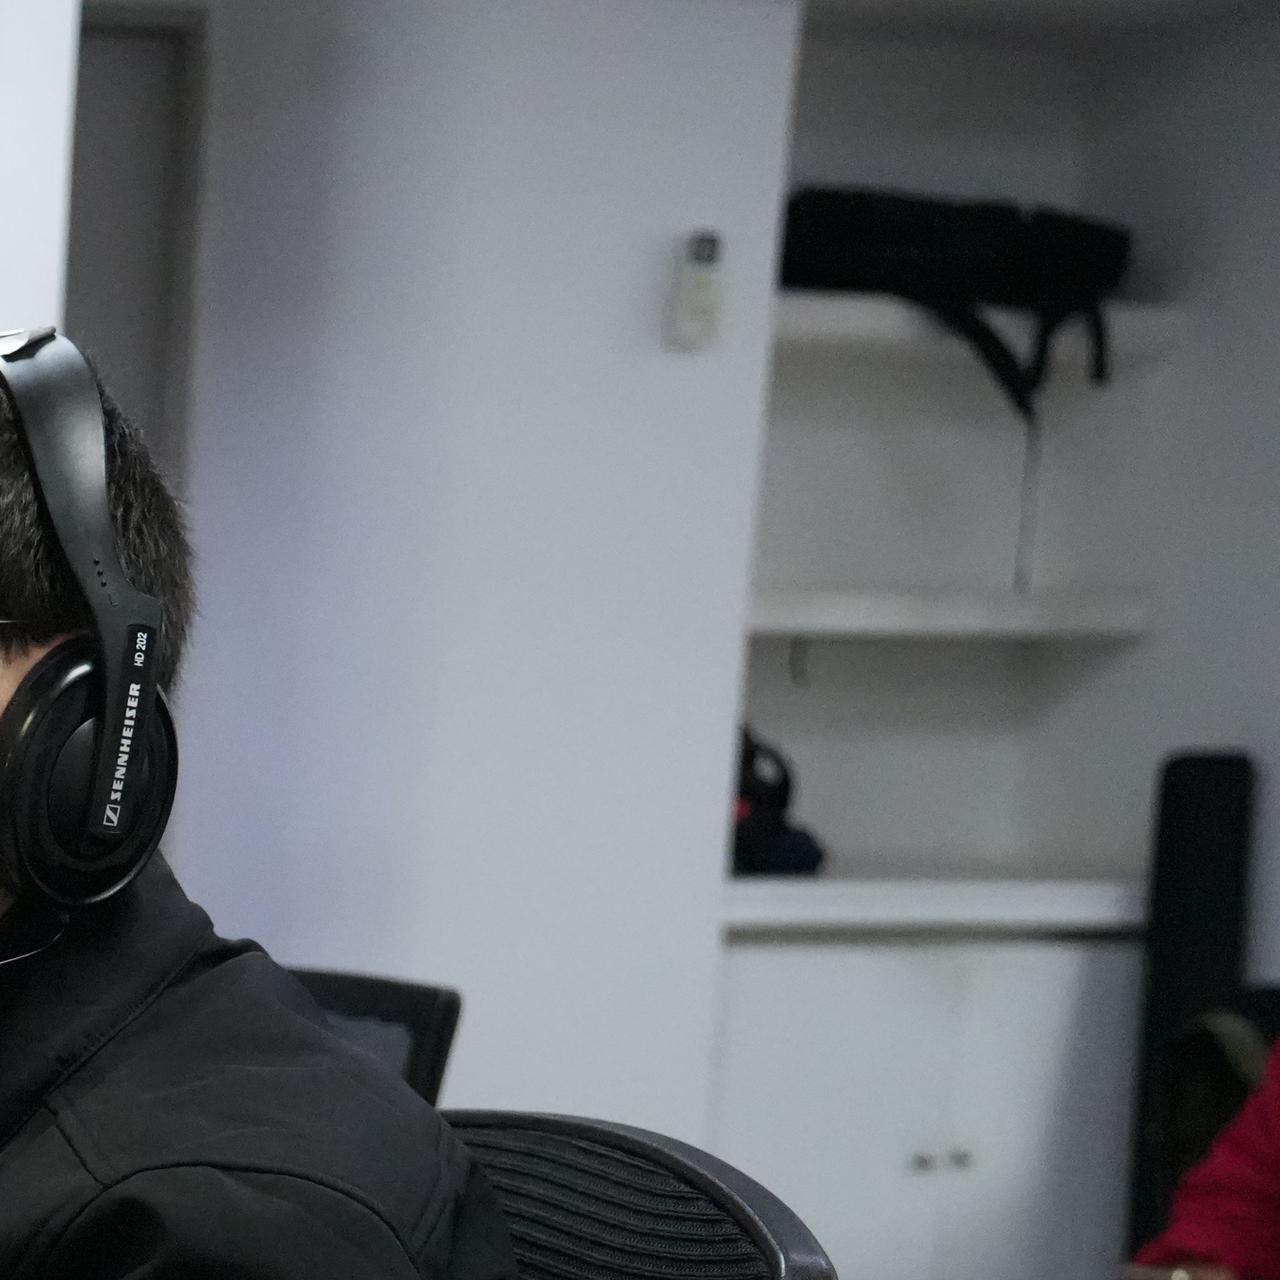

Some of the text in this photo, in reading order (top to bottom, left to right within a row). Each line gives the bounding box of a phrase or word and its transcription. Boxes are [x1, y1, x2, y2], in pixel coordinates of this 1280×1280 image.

[133, 631, 148, 667] HD 202
[110, 682, 142, 802] SENNHEISER
